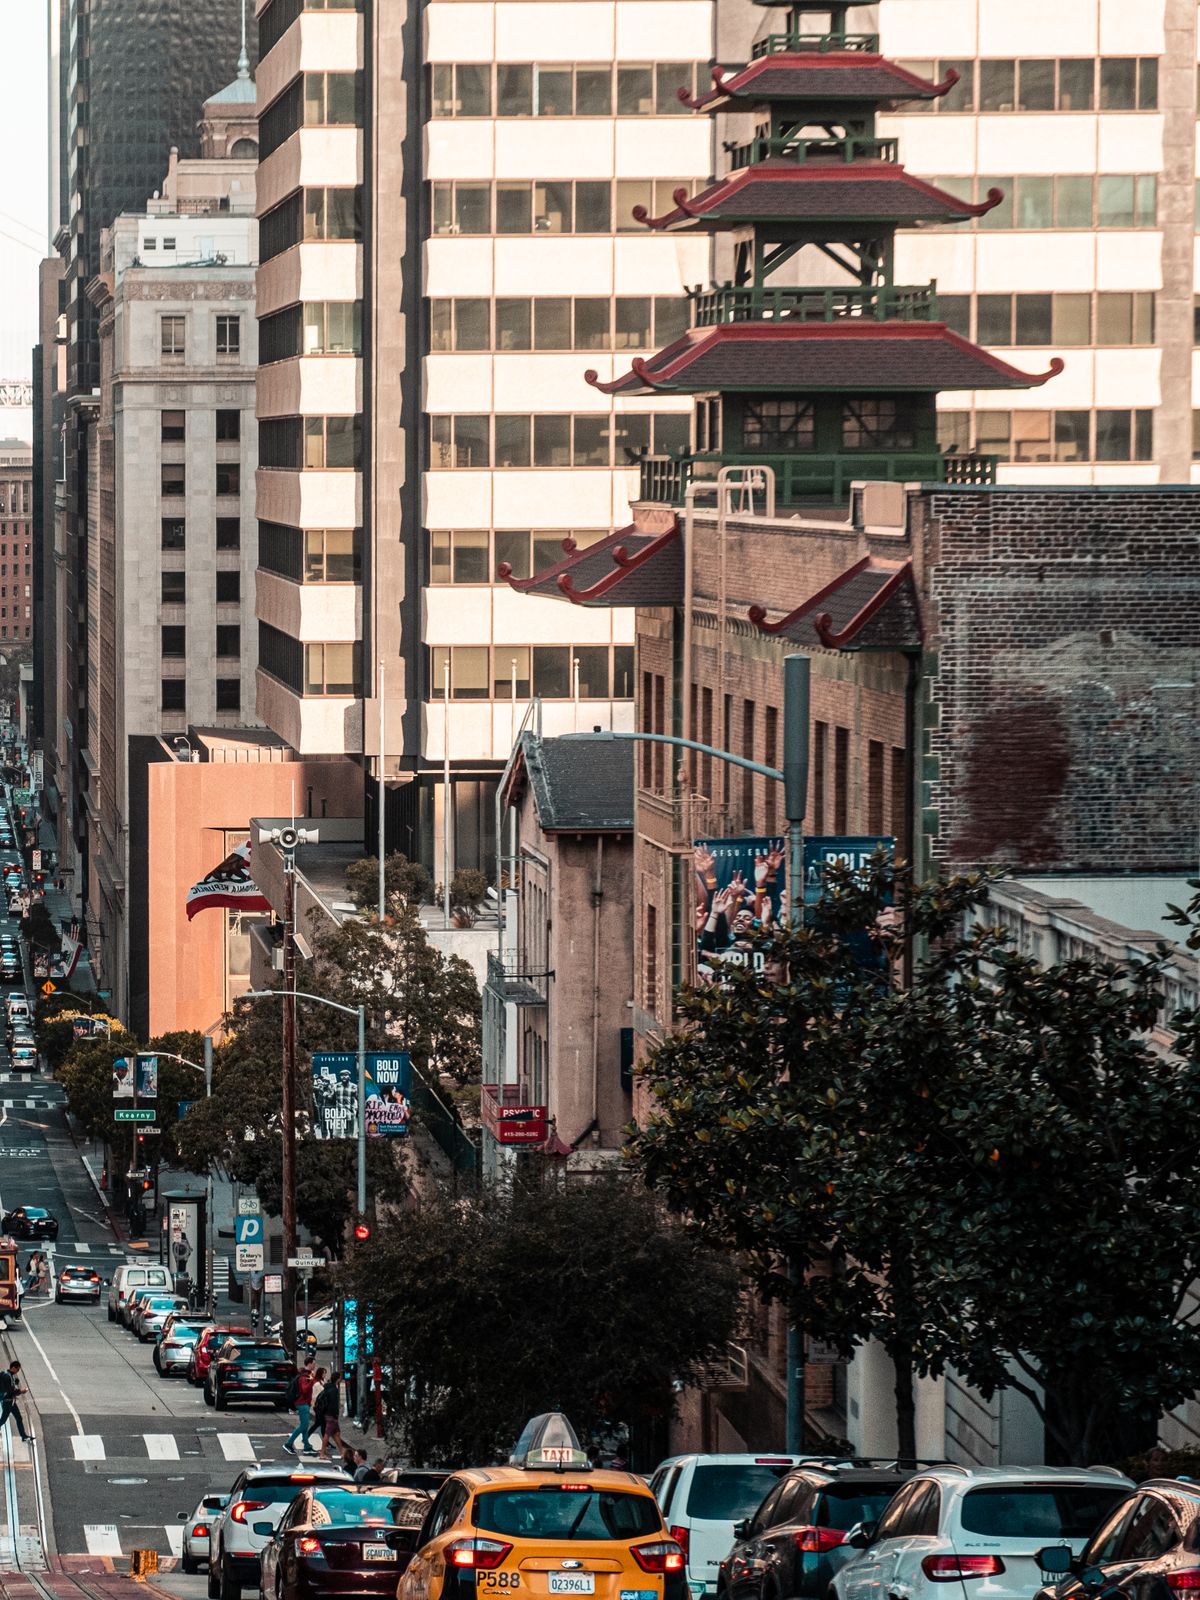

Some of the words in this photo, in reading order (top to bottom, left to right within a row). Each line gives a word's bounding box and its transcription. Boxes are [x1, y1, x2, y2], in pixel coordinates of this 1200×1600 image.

[376, 1060, 398, 1071] BOLD
[376, 1071, 398, 1083] NOW
[324, 1108, 347, 1119] BOLD
[324, 1119, 347, 1130] THEN
[543, 1449, 570, 1461] TAXI
[476, 1571, 520, 1588] P588
[551, 1579, 592, 1591] 02396L1
